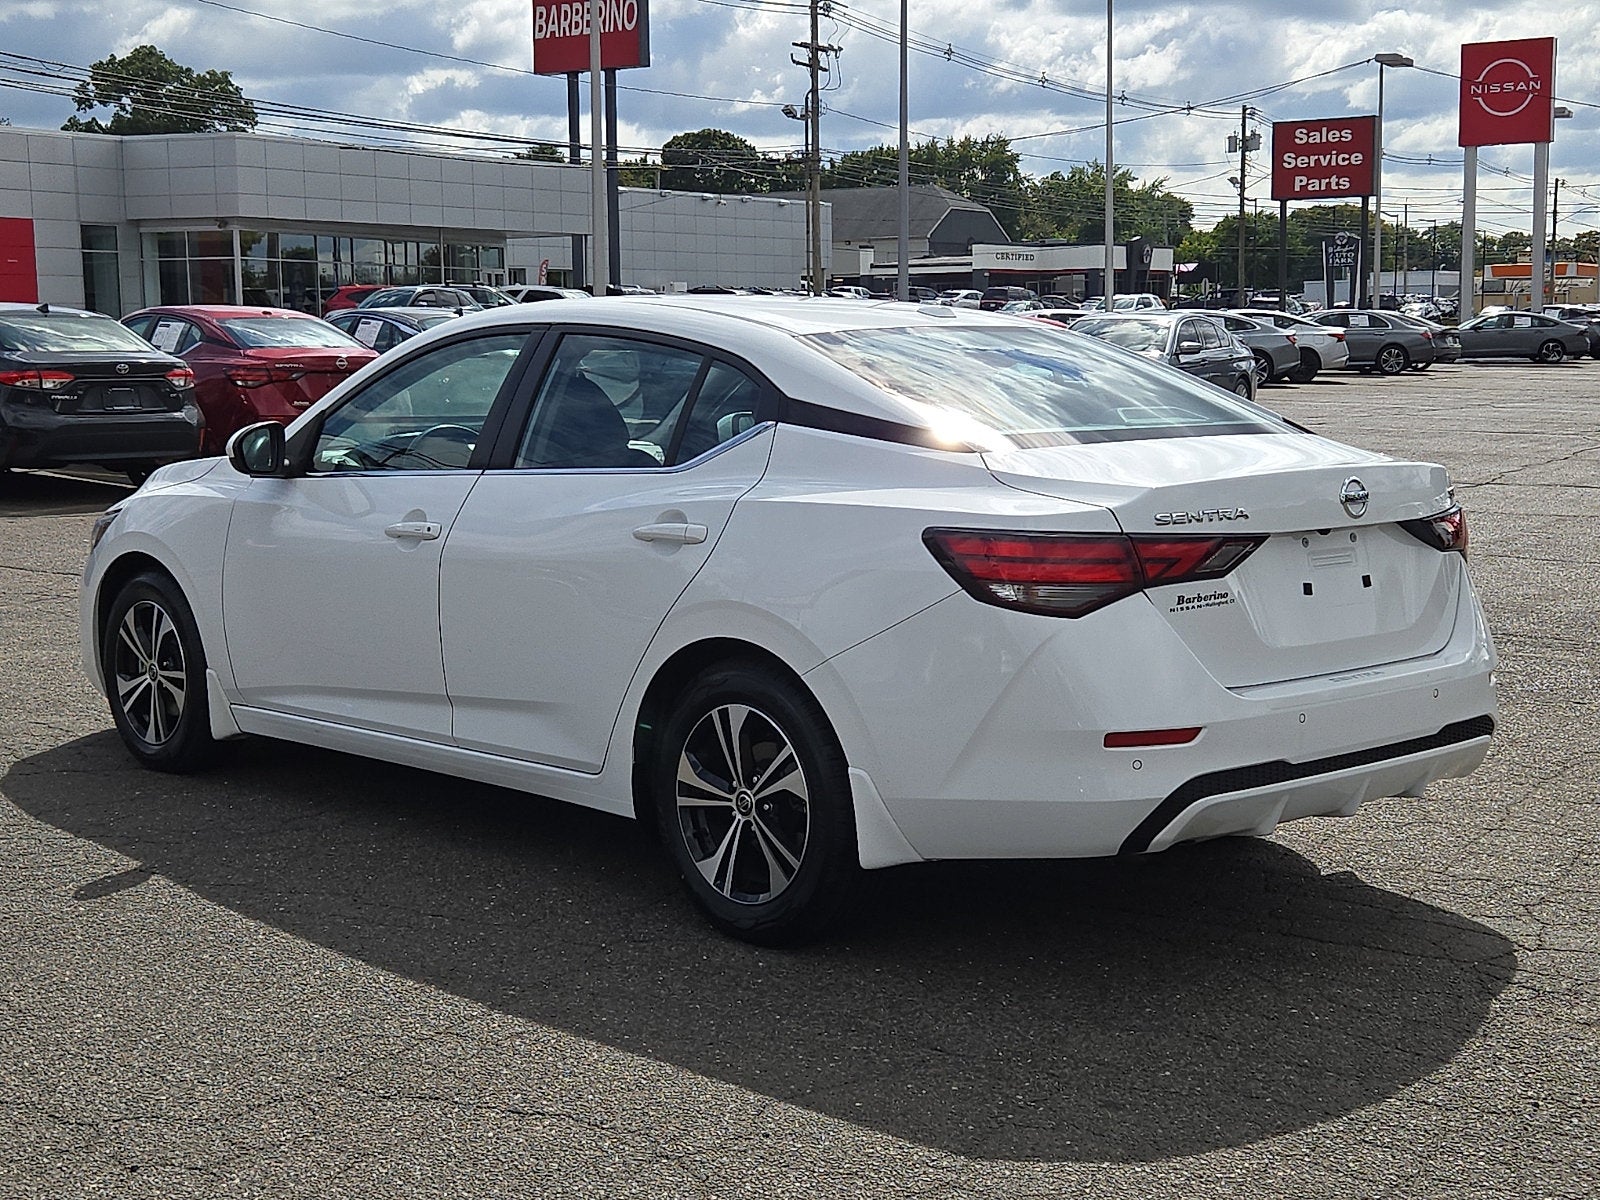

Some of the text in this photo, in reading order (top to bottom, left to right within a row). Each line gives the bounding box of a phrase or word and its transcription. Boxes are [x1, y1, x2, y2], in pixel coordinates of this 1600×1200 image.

[1470, 80, 1541, 95] NISSAN
[1294, 127, 1353, 145] Sales
[1282, 151, 1363, 169] Service
[1294, 175, 1350, 192] Parts
[995, 252, 1035, 261] CERTIFIED
[1154, 507, 1250, 526] SENTRA
[1176, 590, 1229, 606] Barberino
